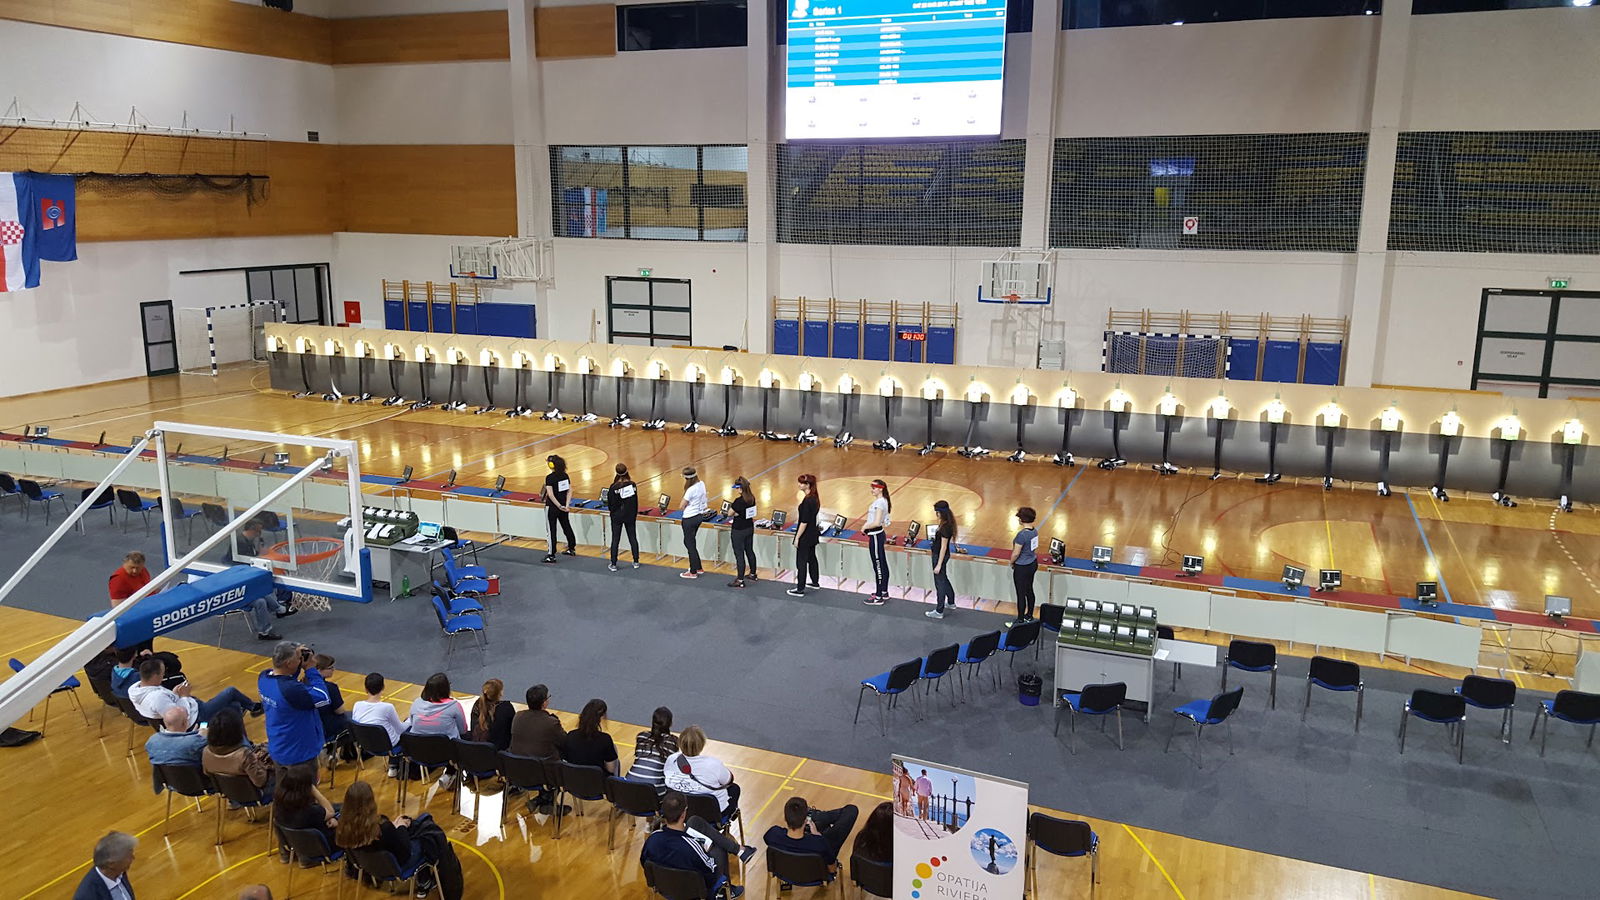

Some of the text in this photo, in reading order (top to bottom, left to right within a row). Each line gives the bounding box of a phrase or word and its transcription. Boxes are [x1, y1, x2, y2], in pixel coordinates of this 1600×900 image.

[153, 585, 246, 628] SPORT SYSTEM
[937, 872, 988, 893] OPATIJA
